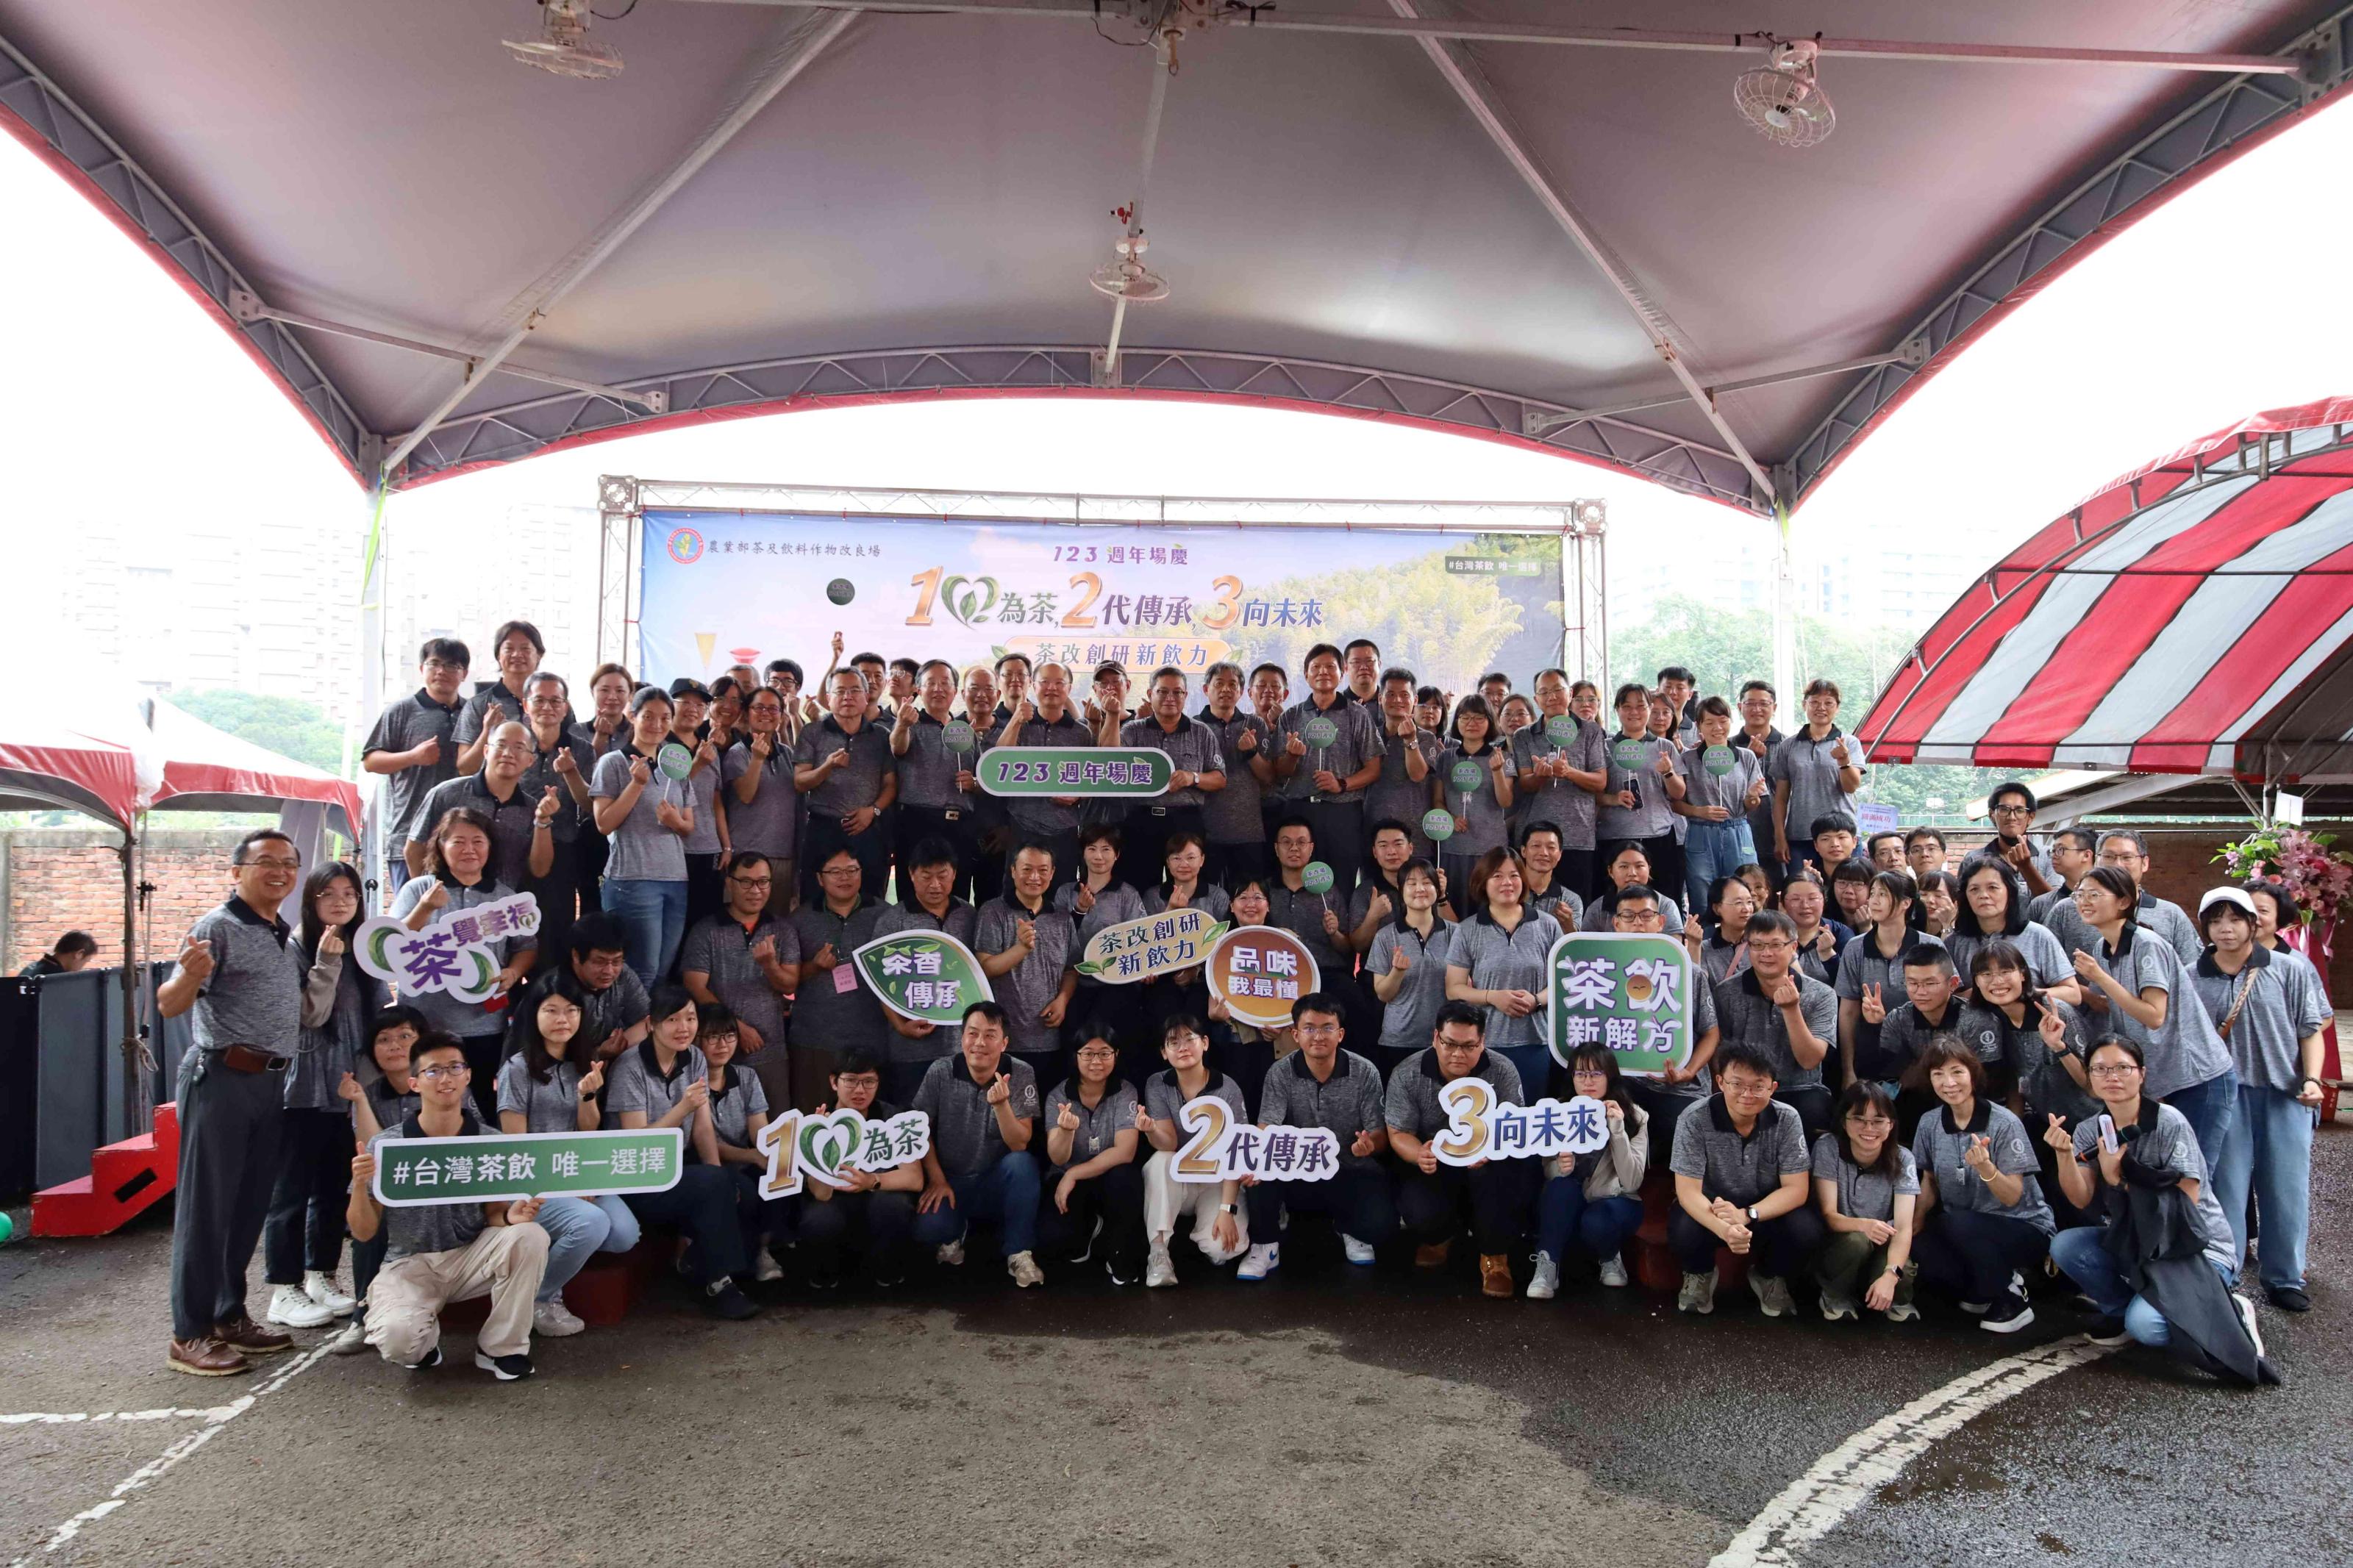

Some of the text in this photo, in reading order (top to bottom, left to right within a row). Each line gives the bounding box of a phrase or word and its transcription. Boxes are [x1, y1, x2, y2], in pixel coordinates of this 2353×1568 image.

[707, 540, 881, 557] 農業部茶及飲料作物改良場
[1035, 642, 1207, 666] 茶改創研新飲力
[1099, 912, 1201, 955] 茶改創研
[882, 945, 942, 976] 茶香
[1118, 939, 1195, 976] 新飲力
[1229, 945, 1298, 978] 品味
[904, 980, 962, 1010] 傳承
[1228, 975, 1299, 1000] 我最懂
[1556, 955, 1682, 1013] 茶飲
[1566, 1015, 1682, 1053] 新解方
[393, 1146, 666, 1186] #台灣茶飲 唯一選擇
